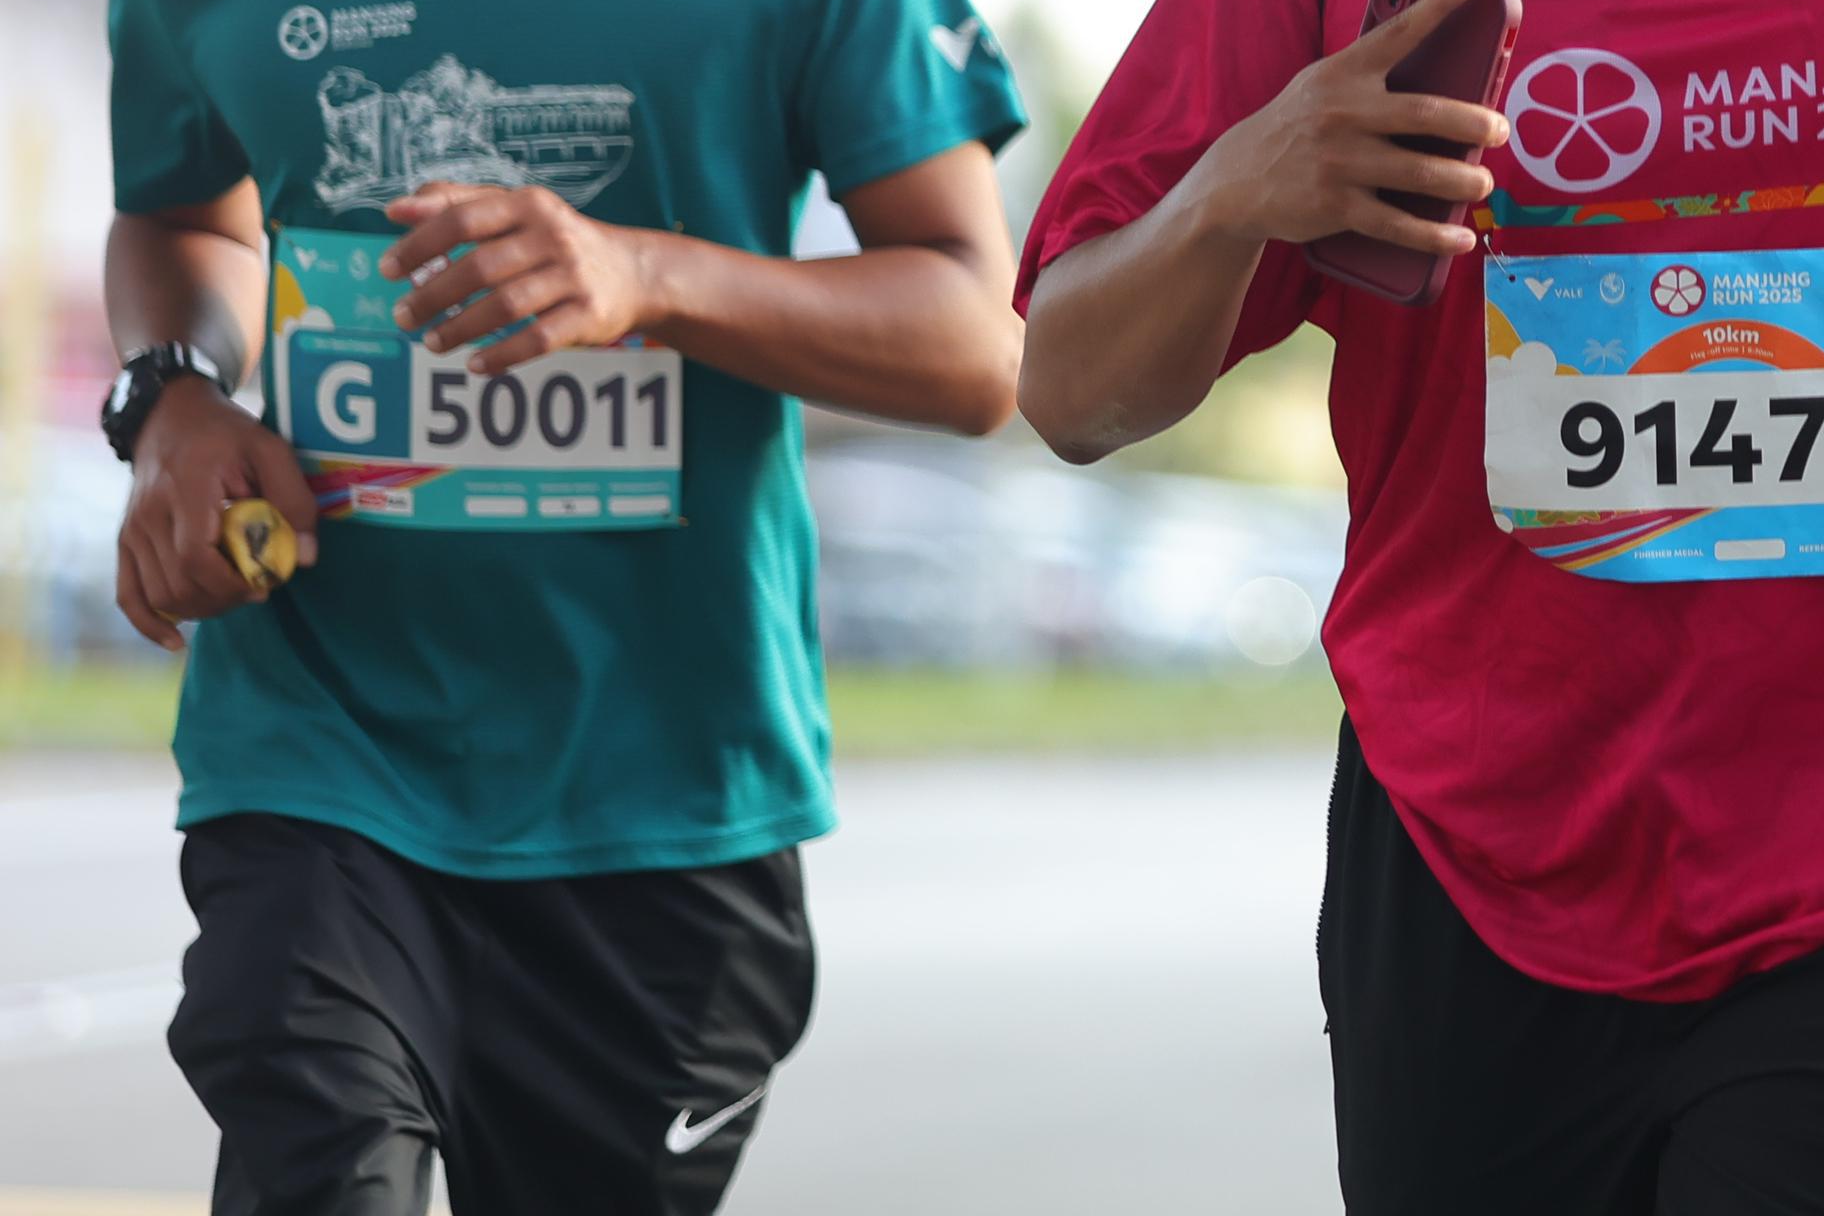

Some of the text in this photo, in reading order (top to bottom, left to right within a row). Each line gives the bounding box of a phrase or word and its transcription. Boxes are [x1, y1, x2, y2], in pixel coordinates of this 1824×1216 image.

[1683, 104, 1799, 152] RUN
[1712, 271, 1811, 290] MANJUNG
[1554, 287, 1583, 300] VALE
[1712, 287, 1802, 306] RUN 2025
[1702, 324, 1760, 345] 10km
[316, 360, 668, 448] G 50011
[1633, 549, 1704, 560] FINISHER MEDAL
